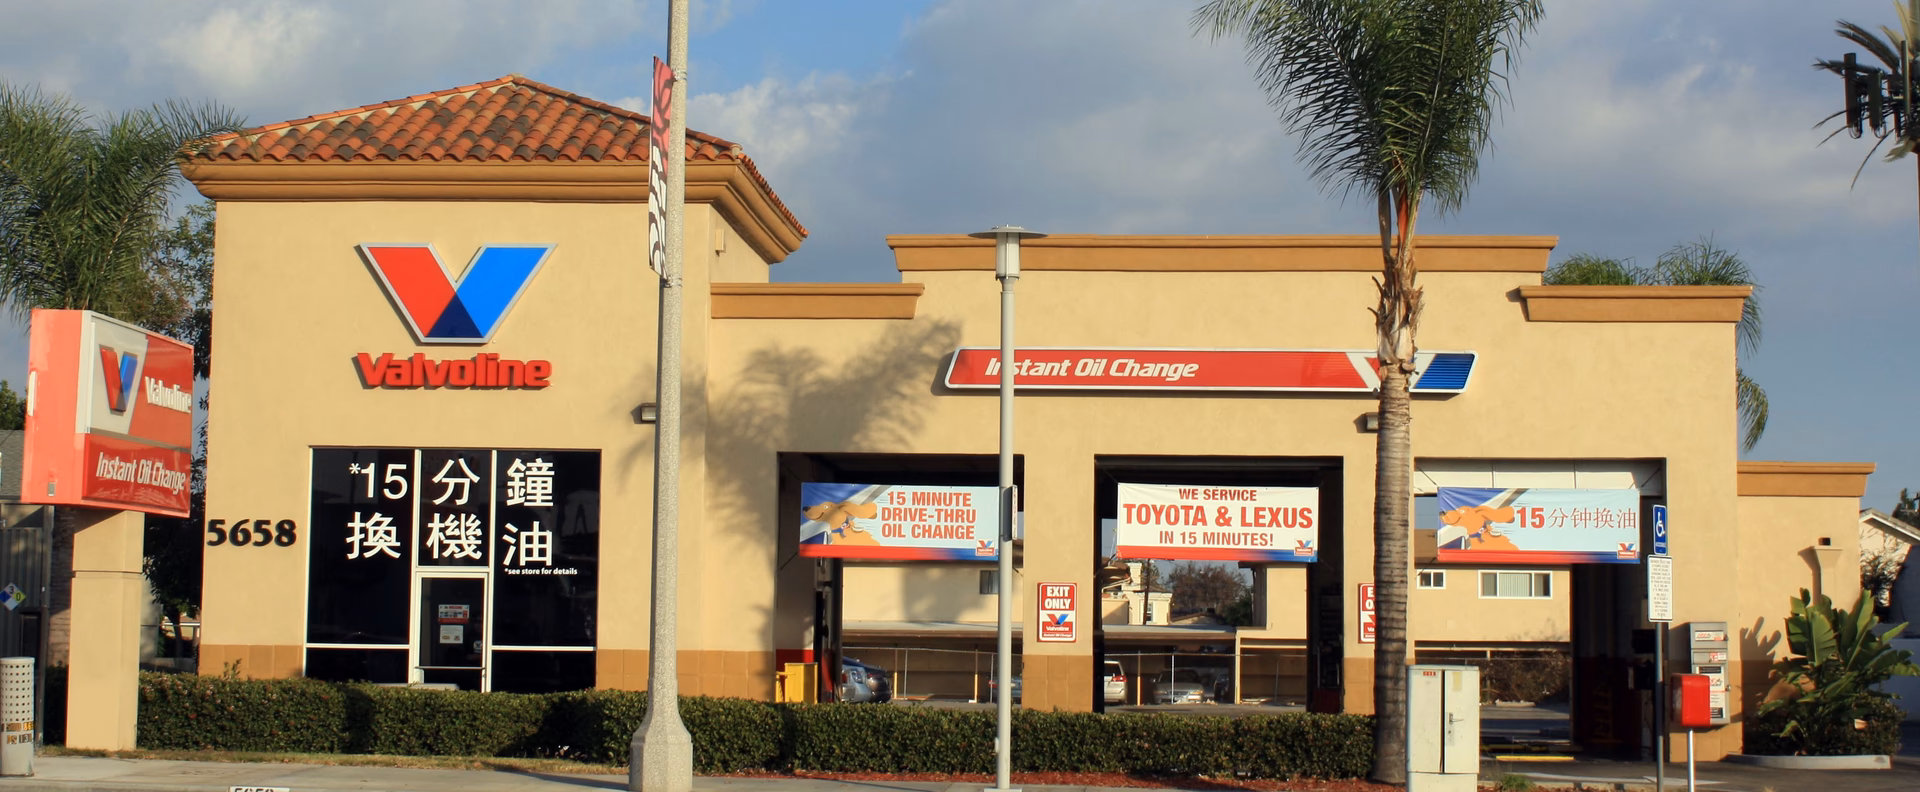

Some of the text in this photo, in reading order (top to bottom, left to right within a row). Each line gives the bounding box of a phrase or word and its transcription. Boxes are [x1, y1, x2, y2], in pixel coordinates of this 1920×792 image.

[356, 352, 552, 387] Valvoline
[1074, 358, 1107, 377] Oil
[1109, 359, 1199, 382] Change
[145, 376, 192, 414] Valvoline
[96, 452, 187, 495] Instant Oil Change
[887, 491, 972, 507] 15 MINUTE
[1179, 488, 1257, 501] WE SERVICE
[881, 507, 977, 524] DRIVE-THRU
[1122, 503, 1313, 529] TOYOTA & LEXUS
[206, 518, 297, 547] 5658
[881, 523, 975, 540] OIL CHANGE
[1159, 530, 1274, 547] IN 15 MINUTES!
[541, 567, 552, 575] for
[553, 567, 578, 575] details
[1046, 586, 1070, 597] EXIT
[1044, 598, 1072, 610] ONLY
